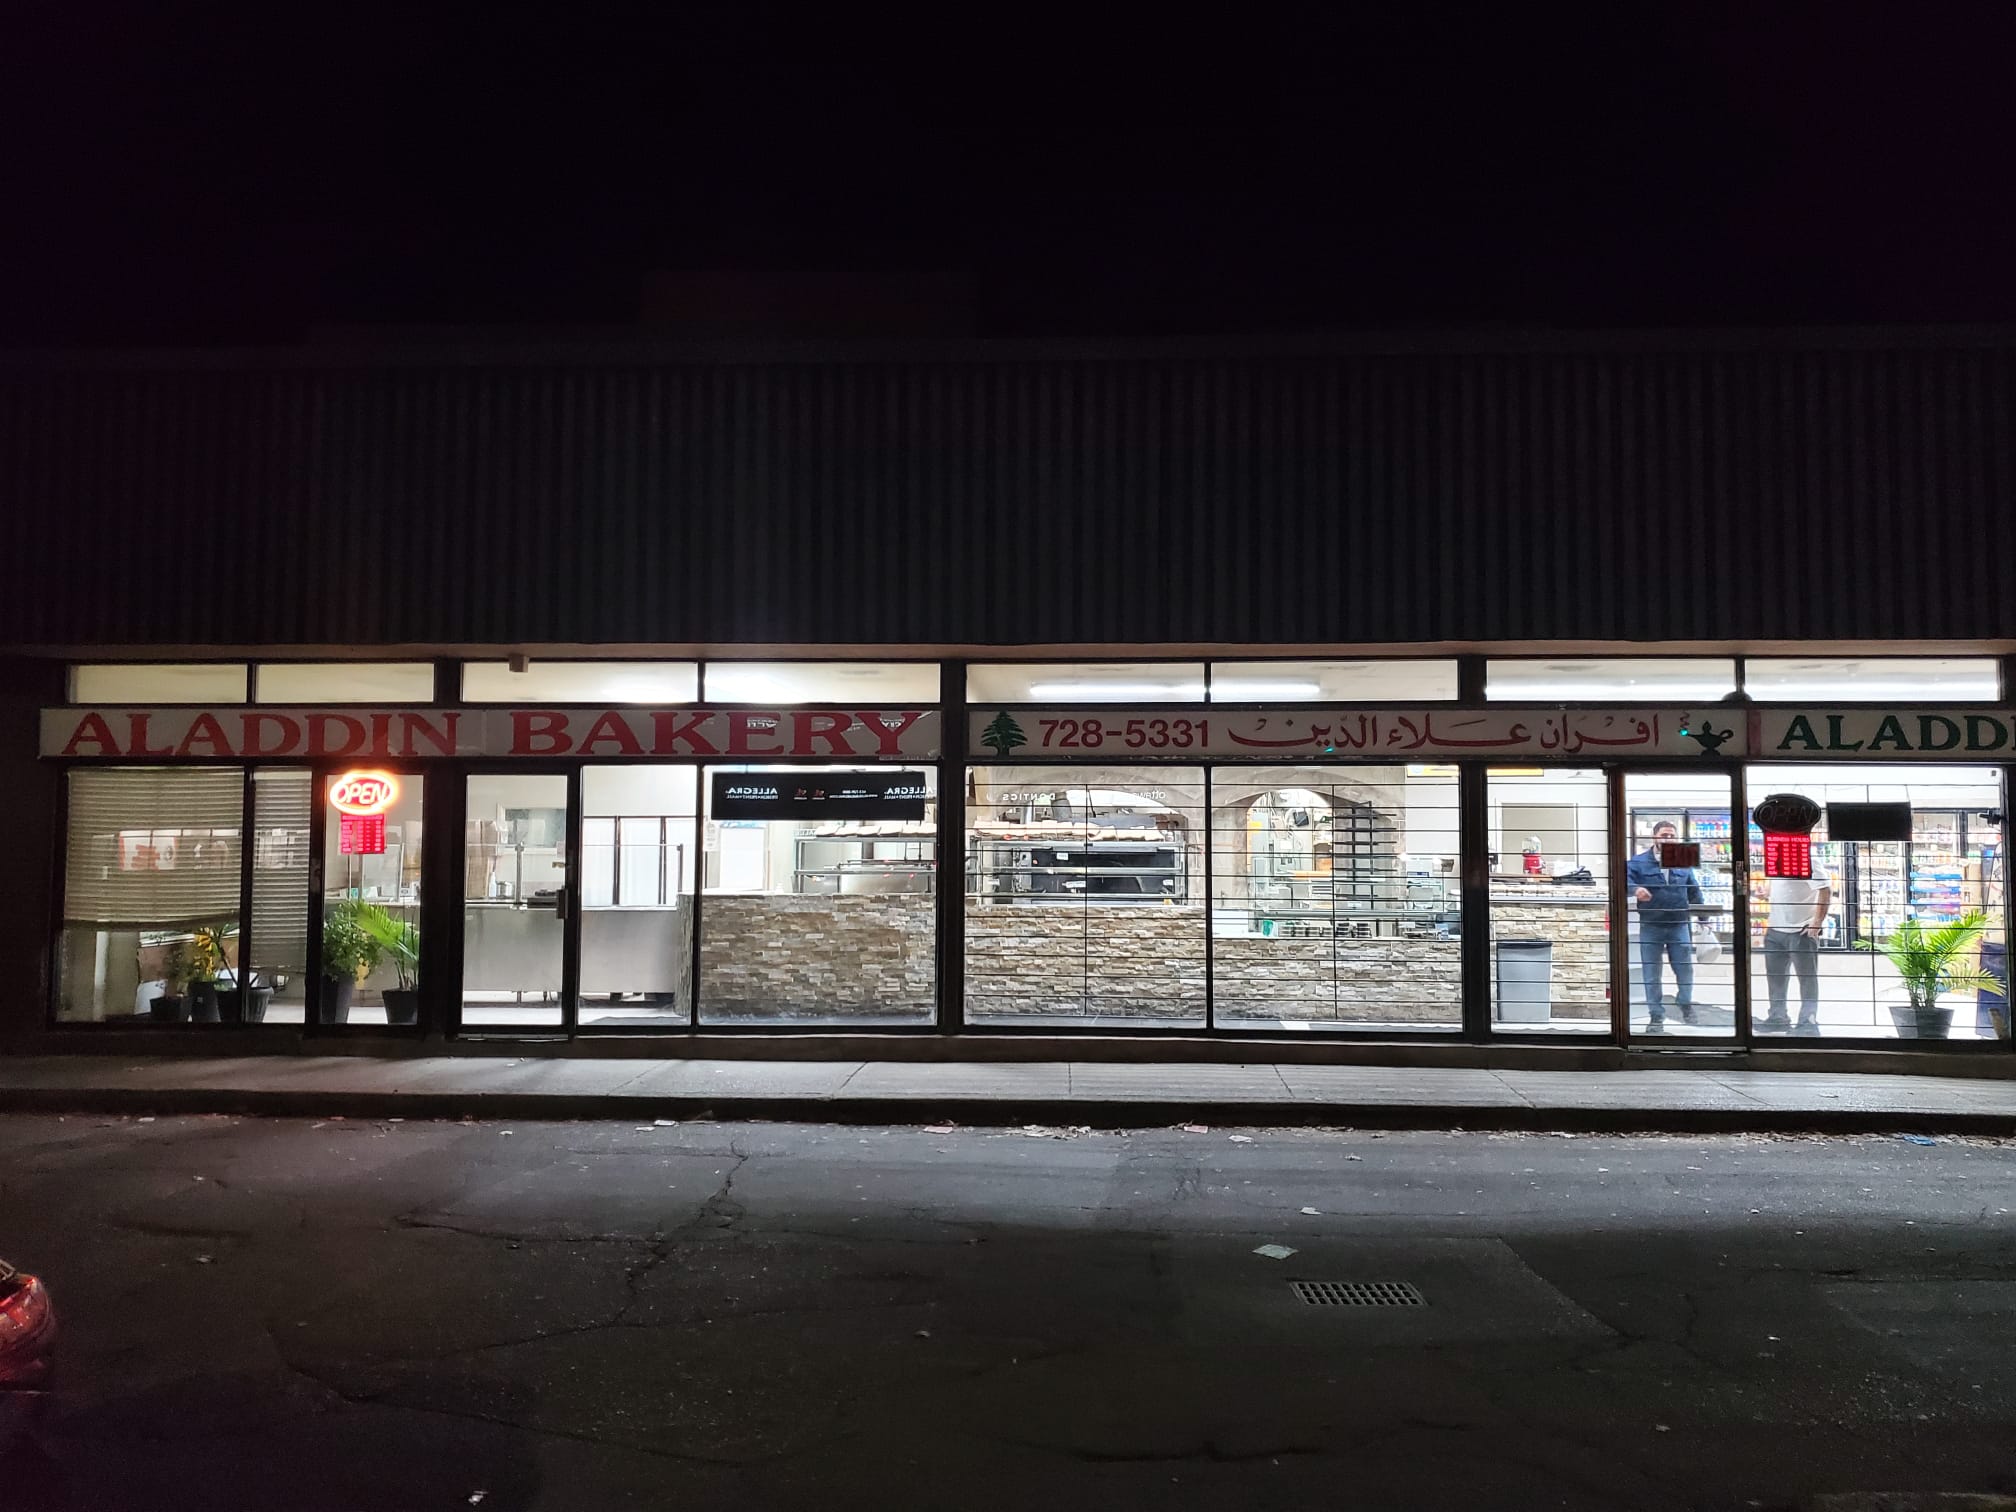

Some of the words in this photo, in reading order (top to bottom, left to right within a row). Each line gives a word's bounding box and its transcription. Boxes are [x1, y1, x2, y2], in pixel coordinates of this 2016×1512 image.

[62, 711, 462, 757] ALADDIN
[509, 711, 922, 756] BAKERY
[1039, 719, 1209, 748] 728-5331
[1777, 713, 2016, 751] ALADD
[336, 782, 388, 805] OPEN
[1759, 805, 1814, 823] OPEN
